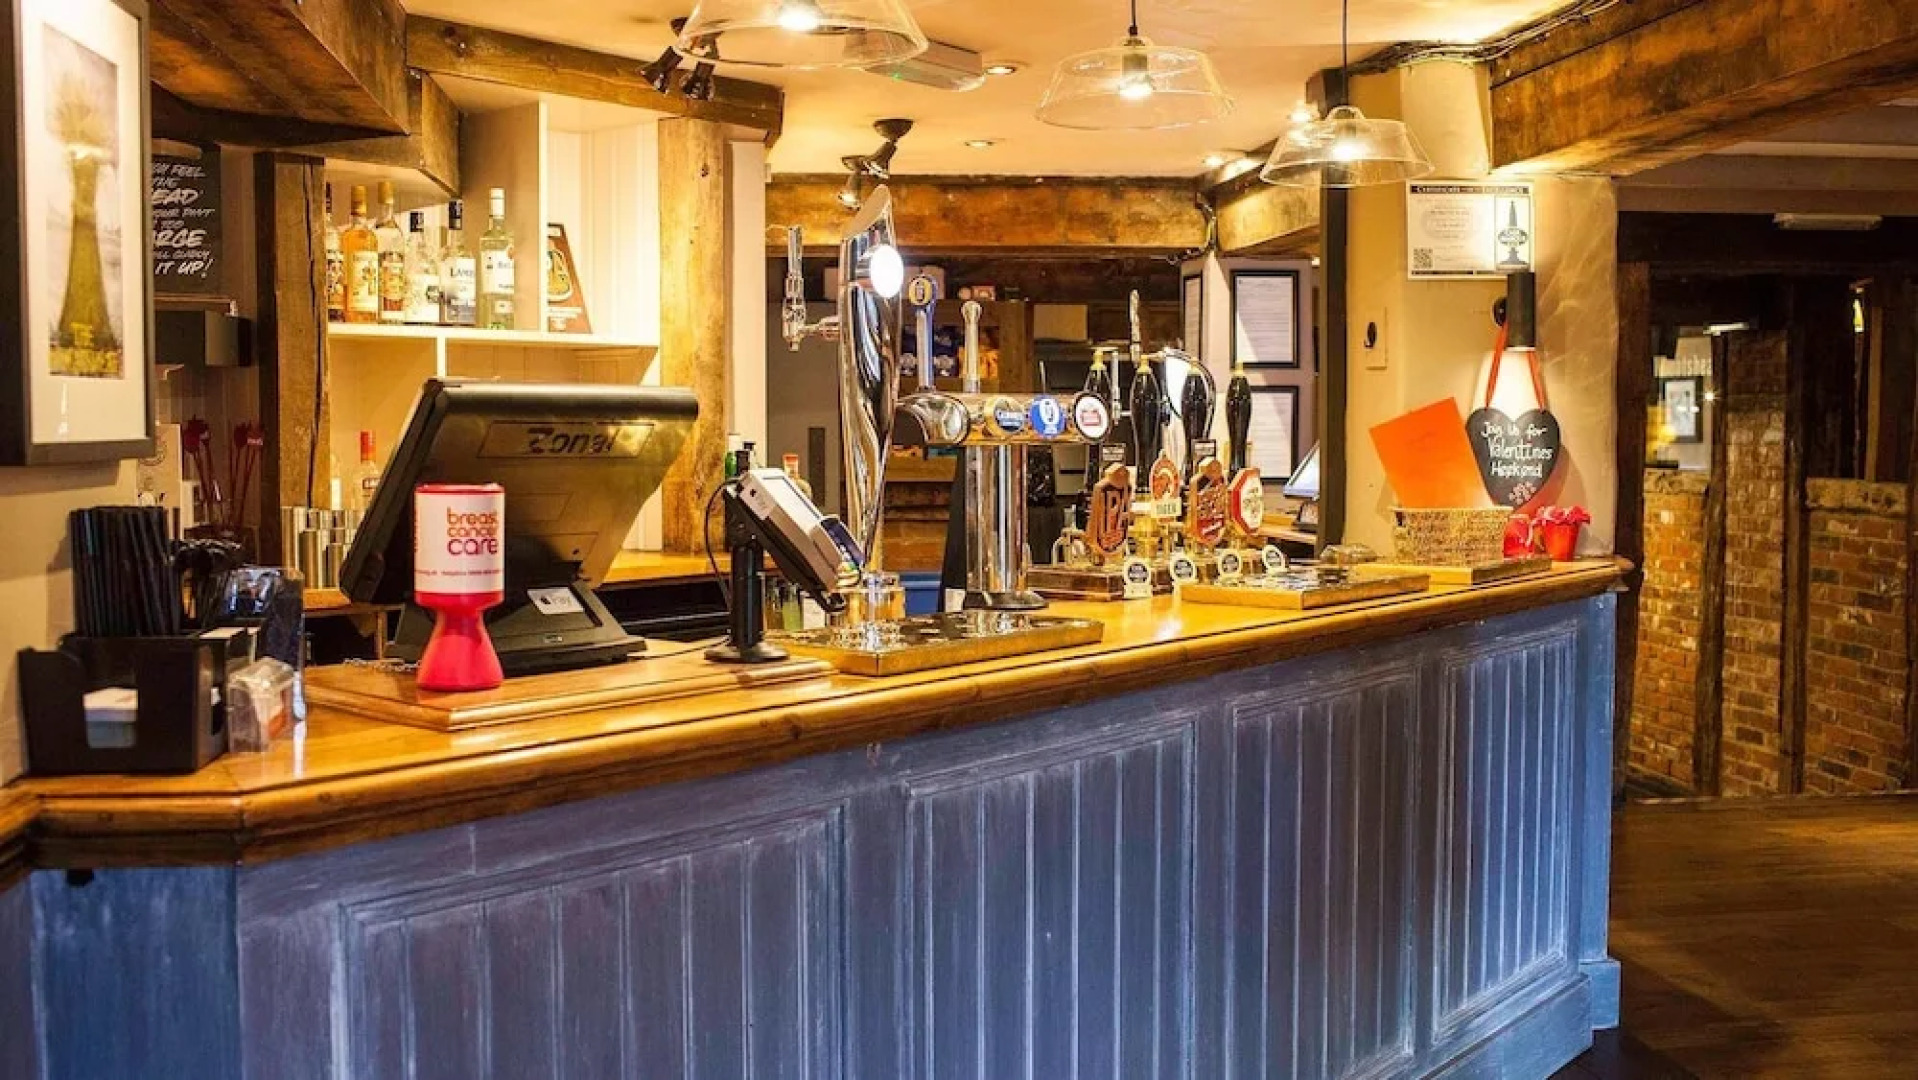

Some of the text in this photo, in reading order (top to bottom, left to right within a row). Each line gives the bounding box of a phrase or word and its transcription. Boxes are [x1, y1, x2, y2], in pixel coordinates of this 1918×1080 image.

[155, 261, 176, 275] IT
[526, 427, 618, 455] Zonal
[1480, 421, 1503, 438] Join
[1526, 423, 1549, 443] for
[1487, 436, 1553, 460] Valentines
[446, 538, 500, 556] care
